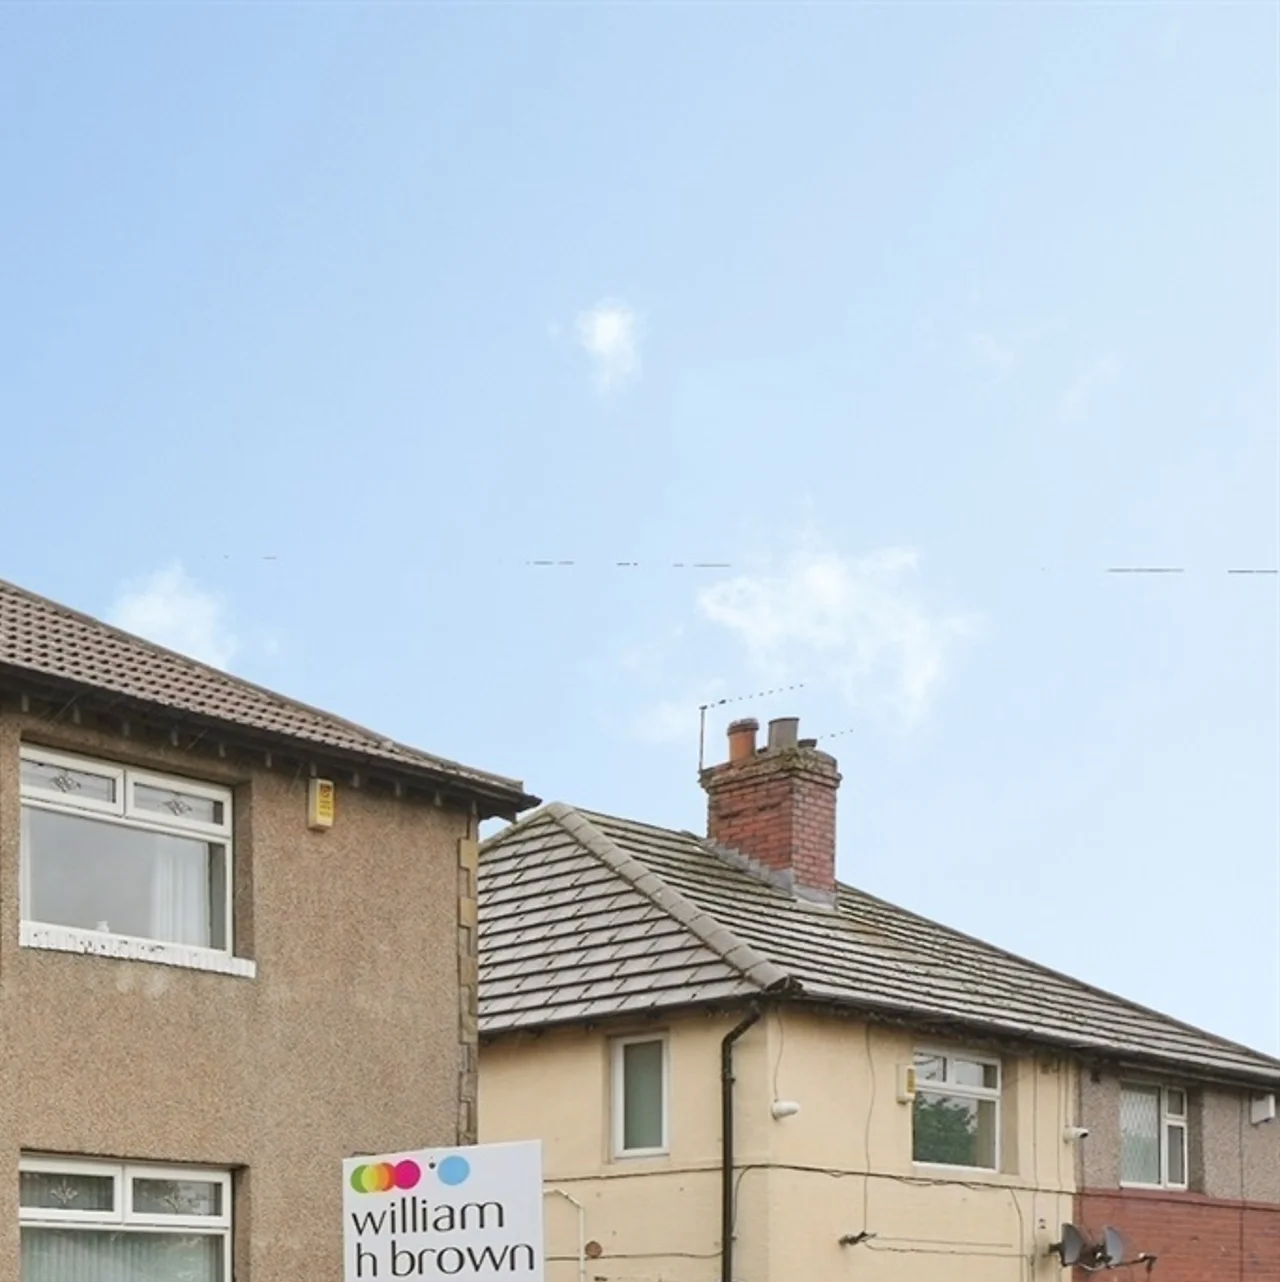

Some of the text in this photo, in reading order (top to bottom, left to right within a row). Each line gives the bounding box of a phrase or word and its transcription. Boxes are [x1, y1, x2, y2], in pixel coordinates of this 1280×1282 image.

[351, 1195, 505, 1236] william
[356, 1239, 535, 1278] h brown
